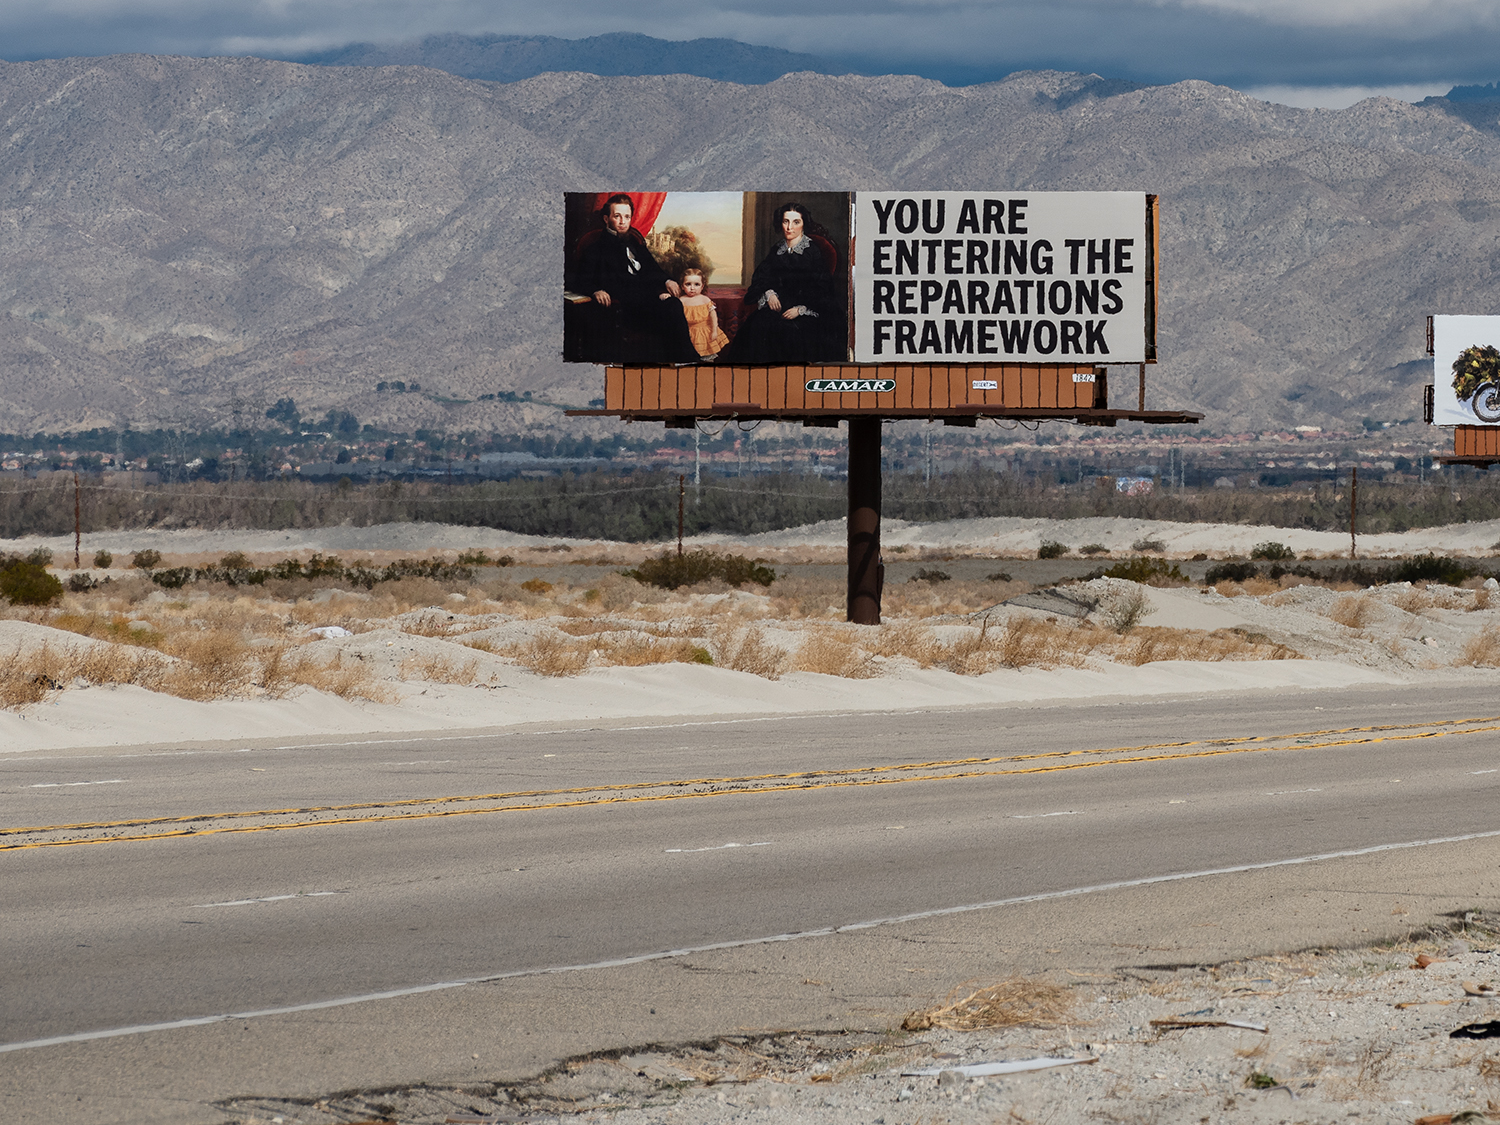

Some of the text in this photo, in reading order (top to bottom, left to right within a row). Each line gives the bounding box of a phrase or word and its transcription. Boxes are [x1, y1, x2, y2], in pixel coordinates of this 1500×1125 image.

[872, 199, 1028, 234] YOU ARE
[873, 239, 1134, 275] ENTERING THE
[872, 279, 1123, 315] REPARATIONS
[873, 319, 1110, 354] FRAMEWORK
[813, 381, 887, 391] LAMAR
